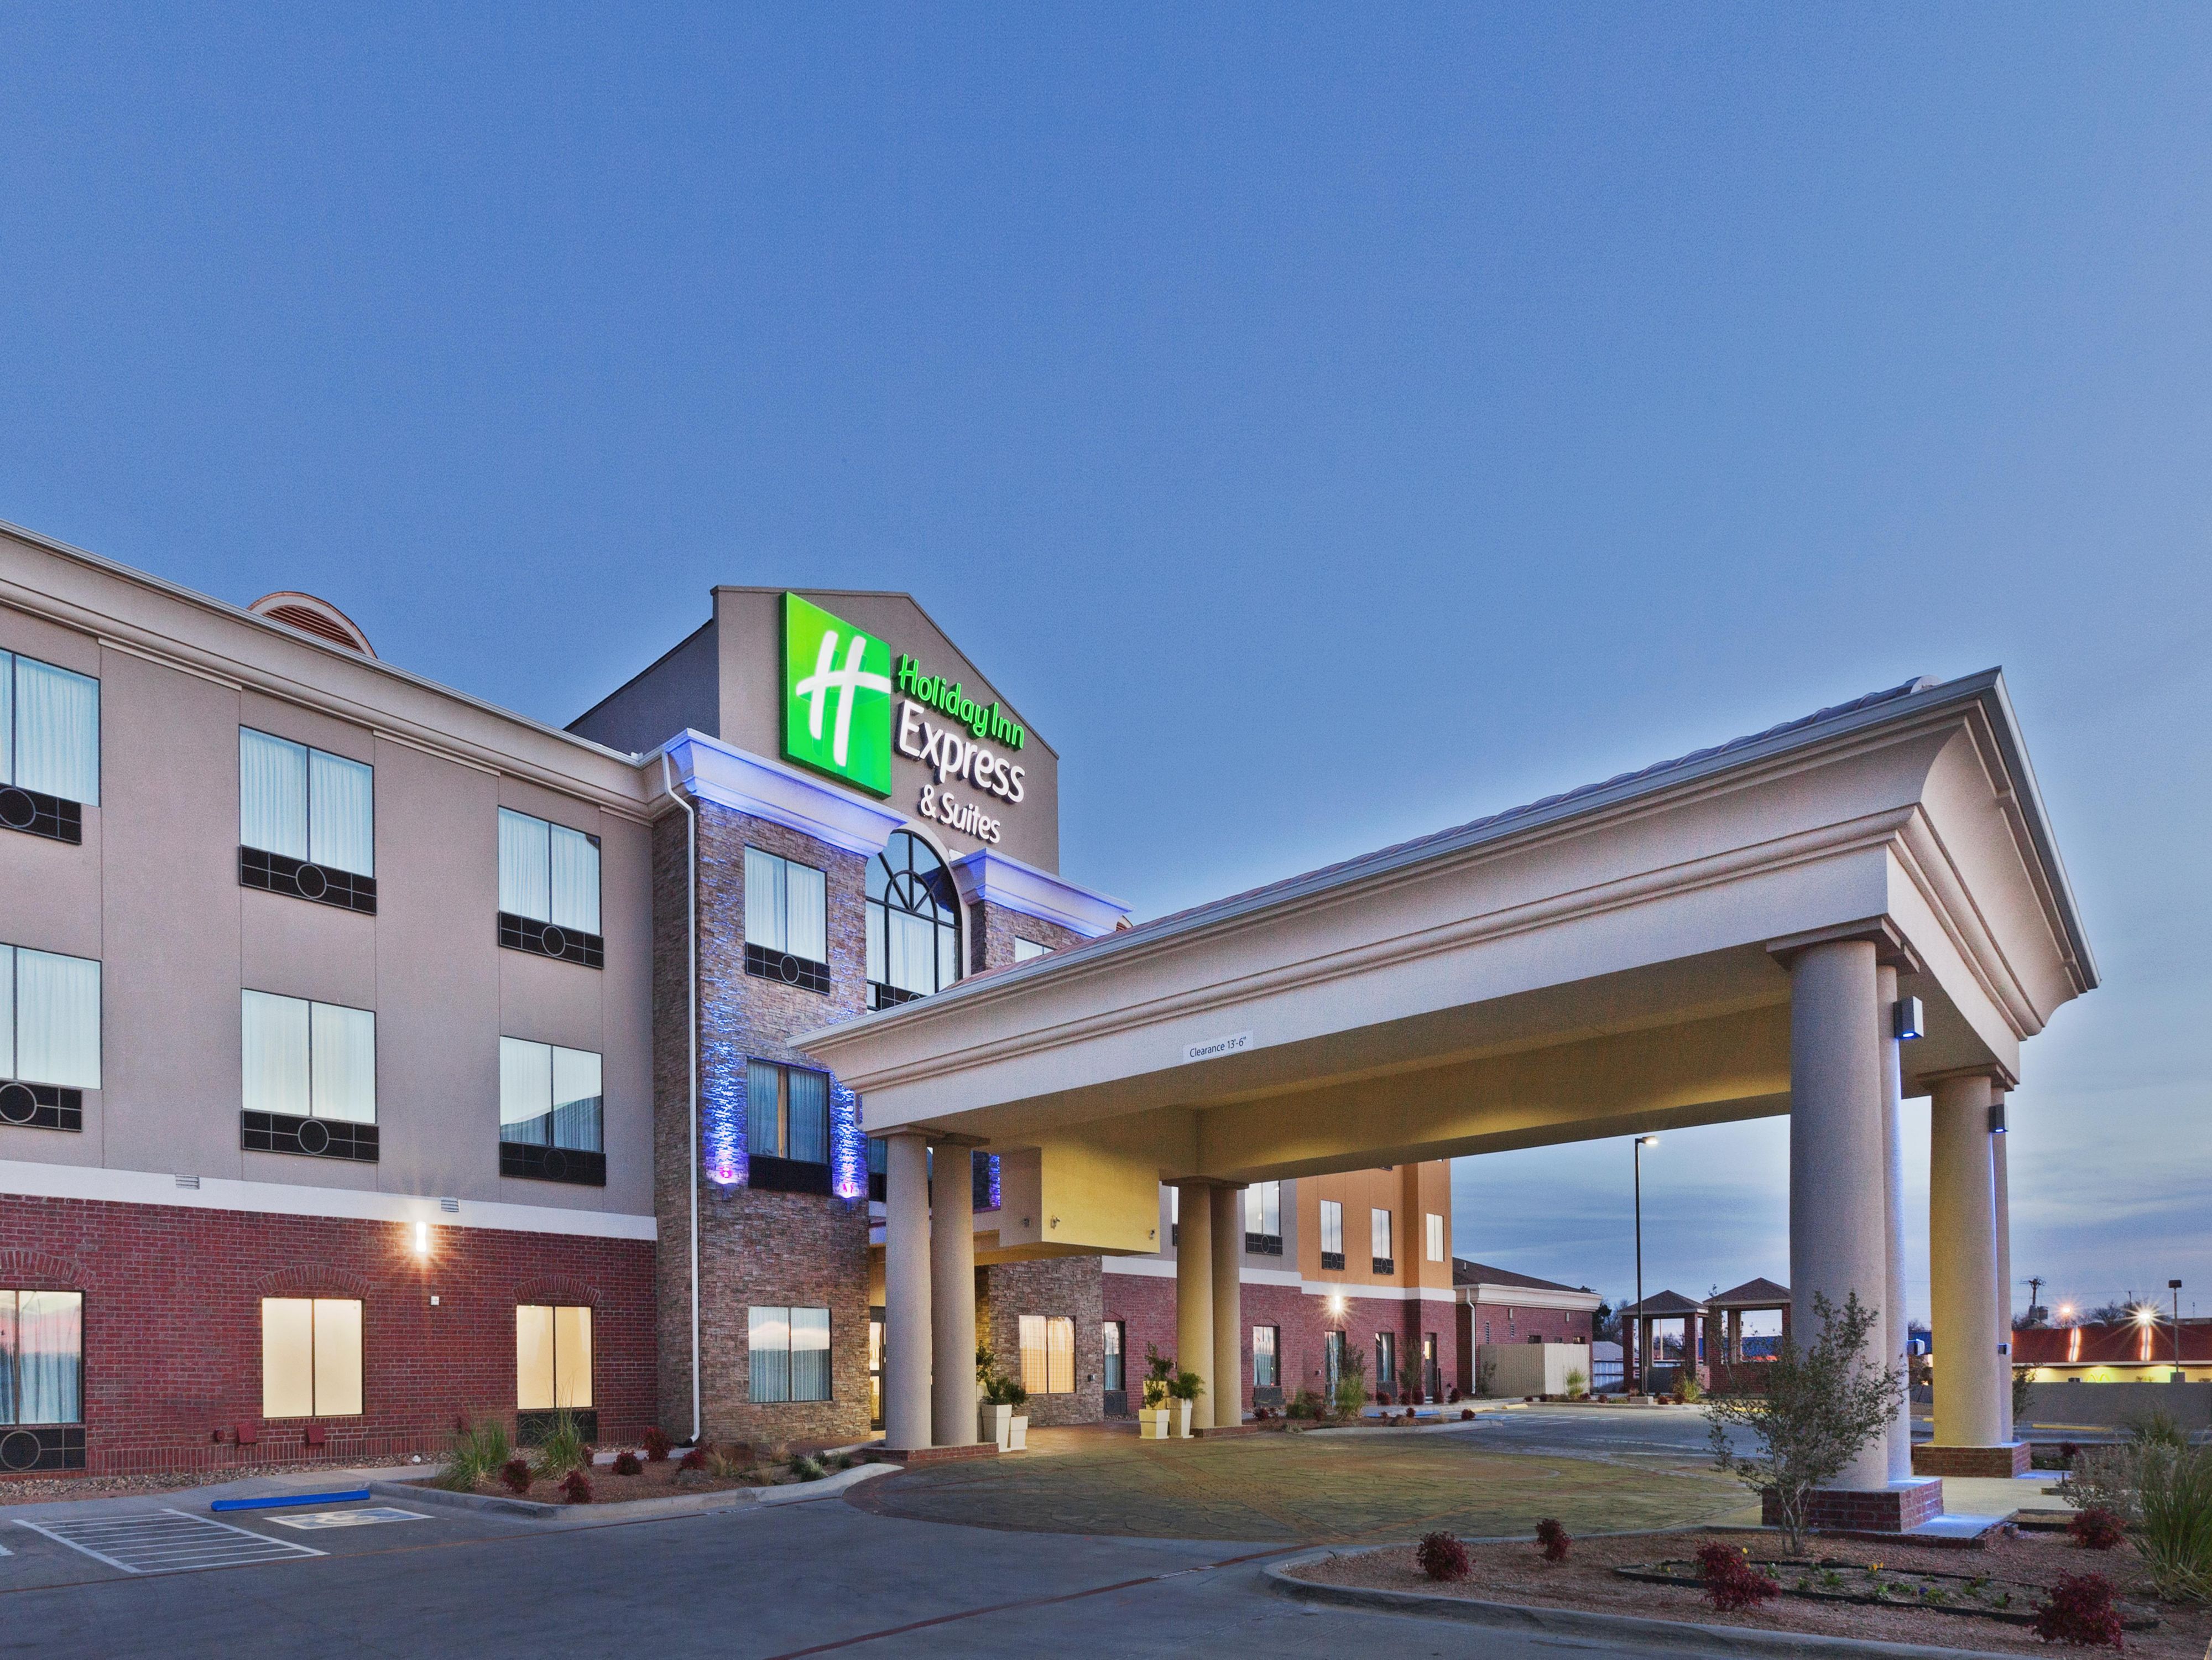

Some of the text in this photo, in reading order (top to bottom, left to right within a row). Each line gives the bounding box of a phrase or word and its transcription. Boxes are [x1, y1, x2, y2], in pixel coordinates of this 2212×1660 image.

[897, 653, 1025, 749] Holiday Inn
[898, 699, 1025, 803] Express
[919, 784, 1000, 843] & Suites
[1190, 1043, 1225, 1058] Clearance
